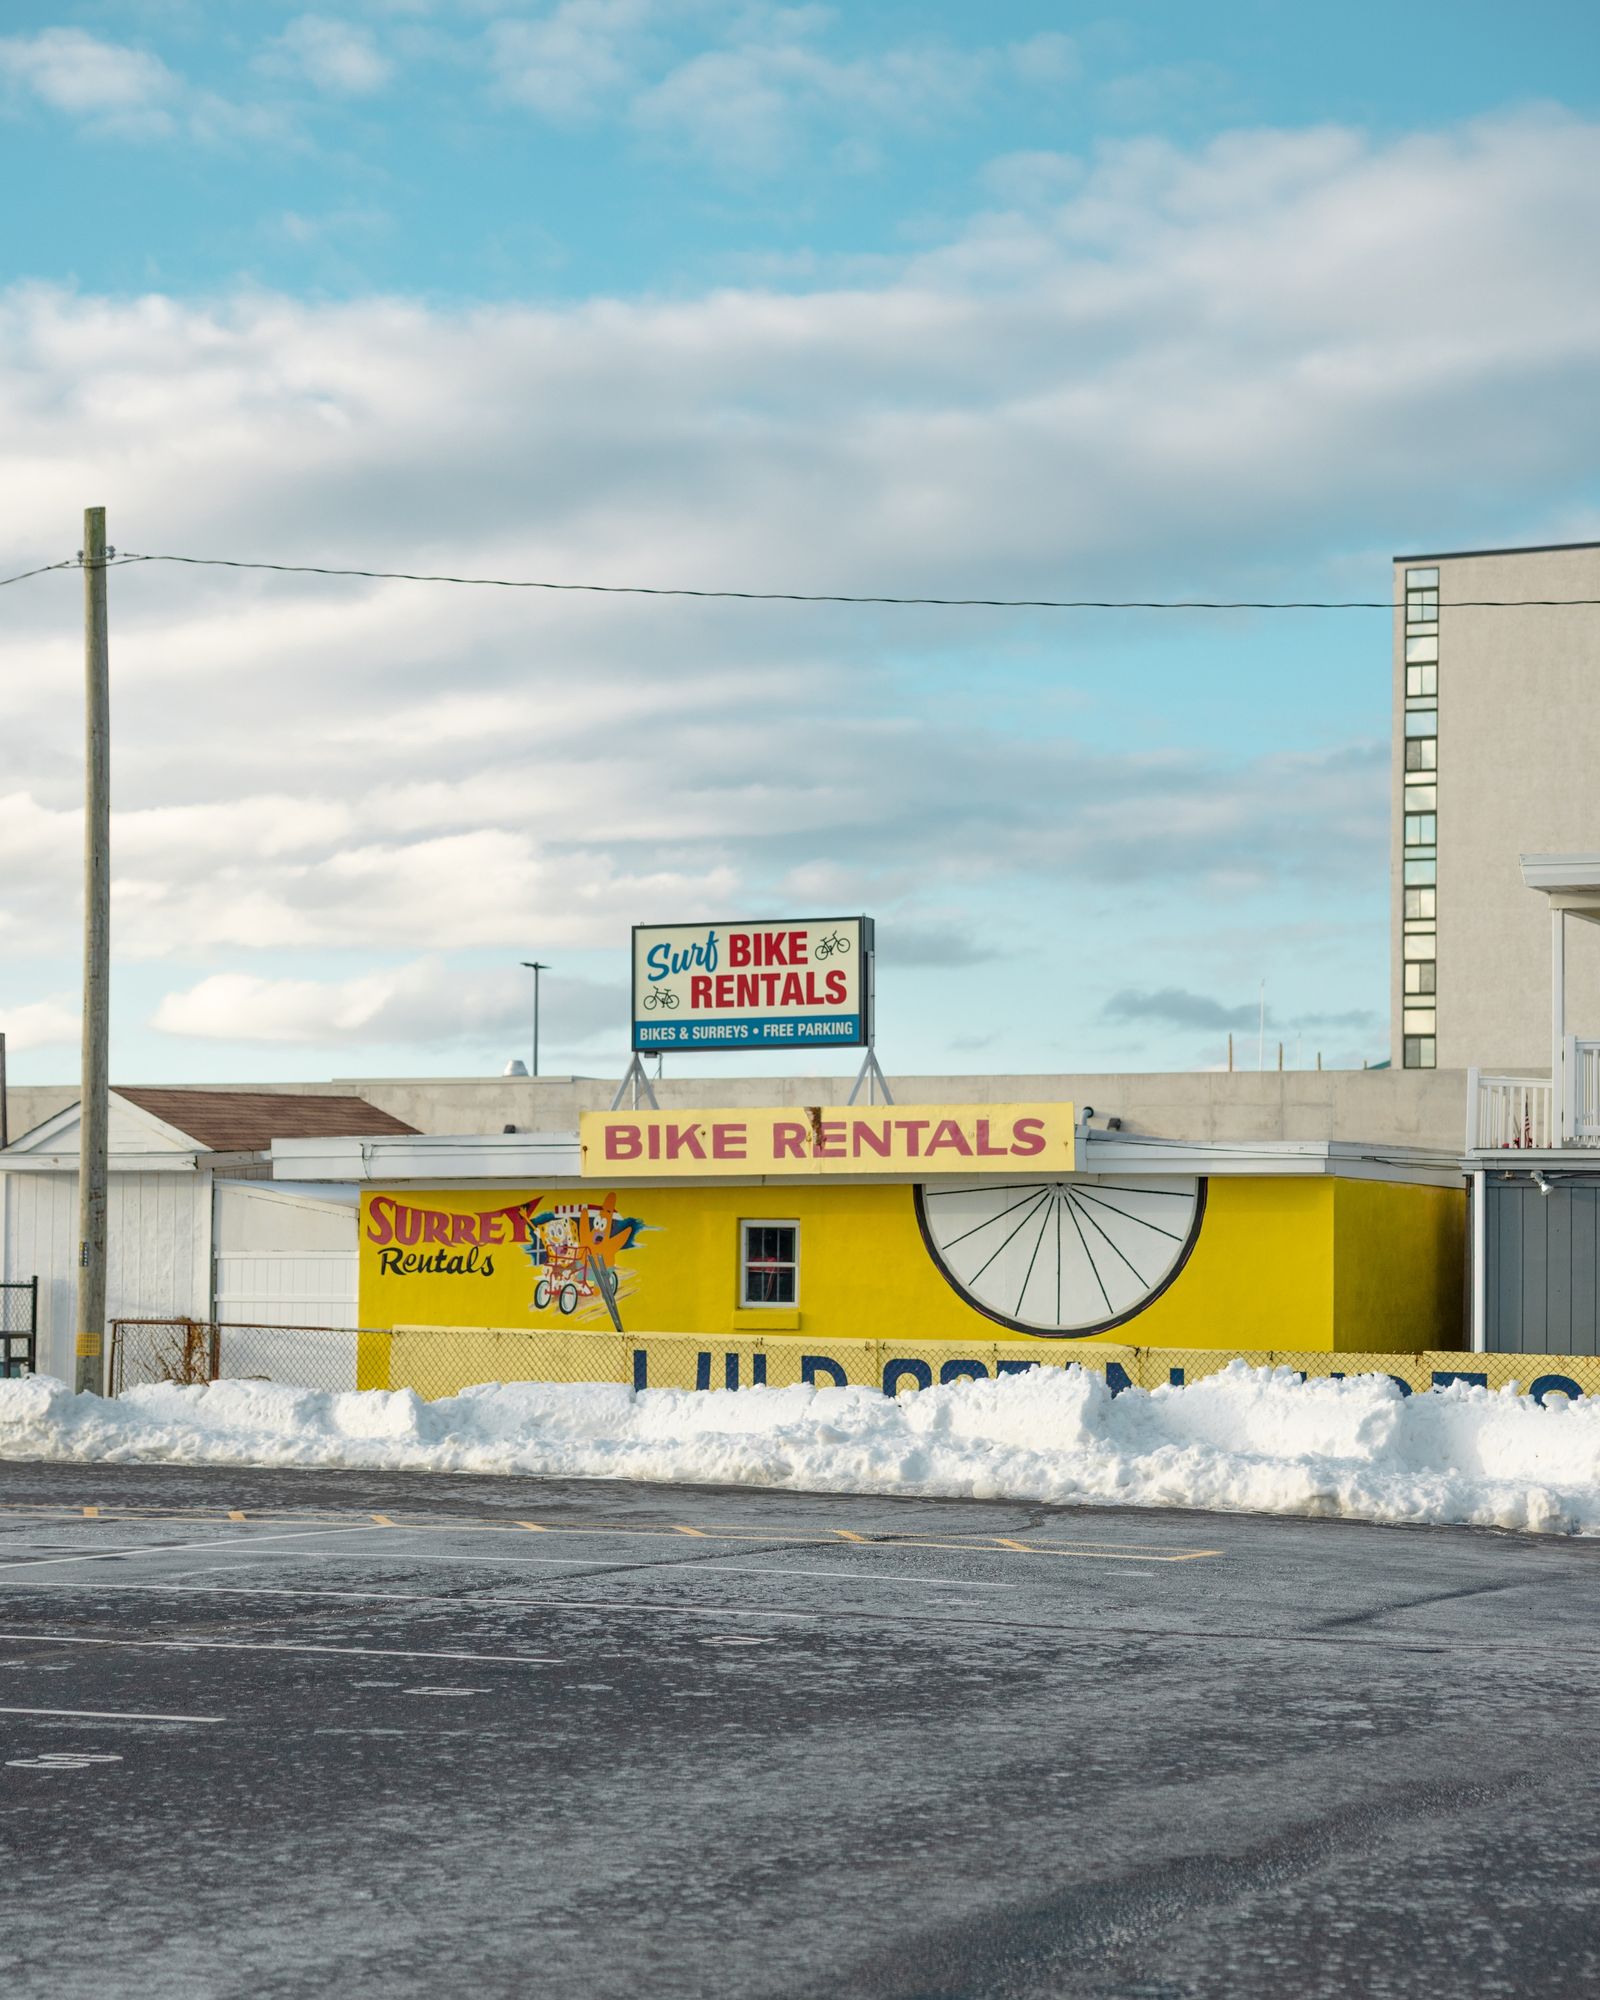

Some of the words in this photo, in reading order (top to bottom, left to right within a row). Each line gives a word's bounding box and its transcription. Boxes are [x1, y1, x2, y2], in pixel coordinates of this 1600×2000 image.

[647, 930, 719, 981] Surf
[729, 931, 808, 968] BIKE
[691, 970, 847, 1009] RENTALS
[640, 1027, 676, 1041] BIKES
[680, 1026, 689, 1040] &
[692, 1025, 748, 1039] SURREYS
[763, 1023, 794, 1037] FREE
[798, 1021, 853, 1036] PARKING
[604, 1123, 747, 1160] BIKE
[772, 1118, 1046, 1159] RENTALS
[367, 1196, 544, 1247] SURREY
[377, 1246, 494, 1277] Rentals
